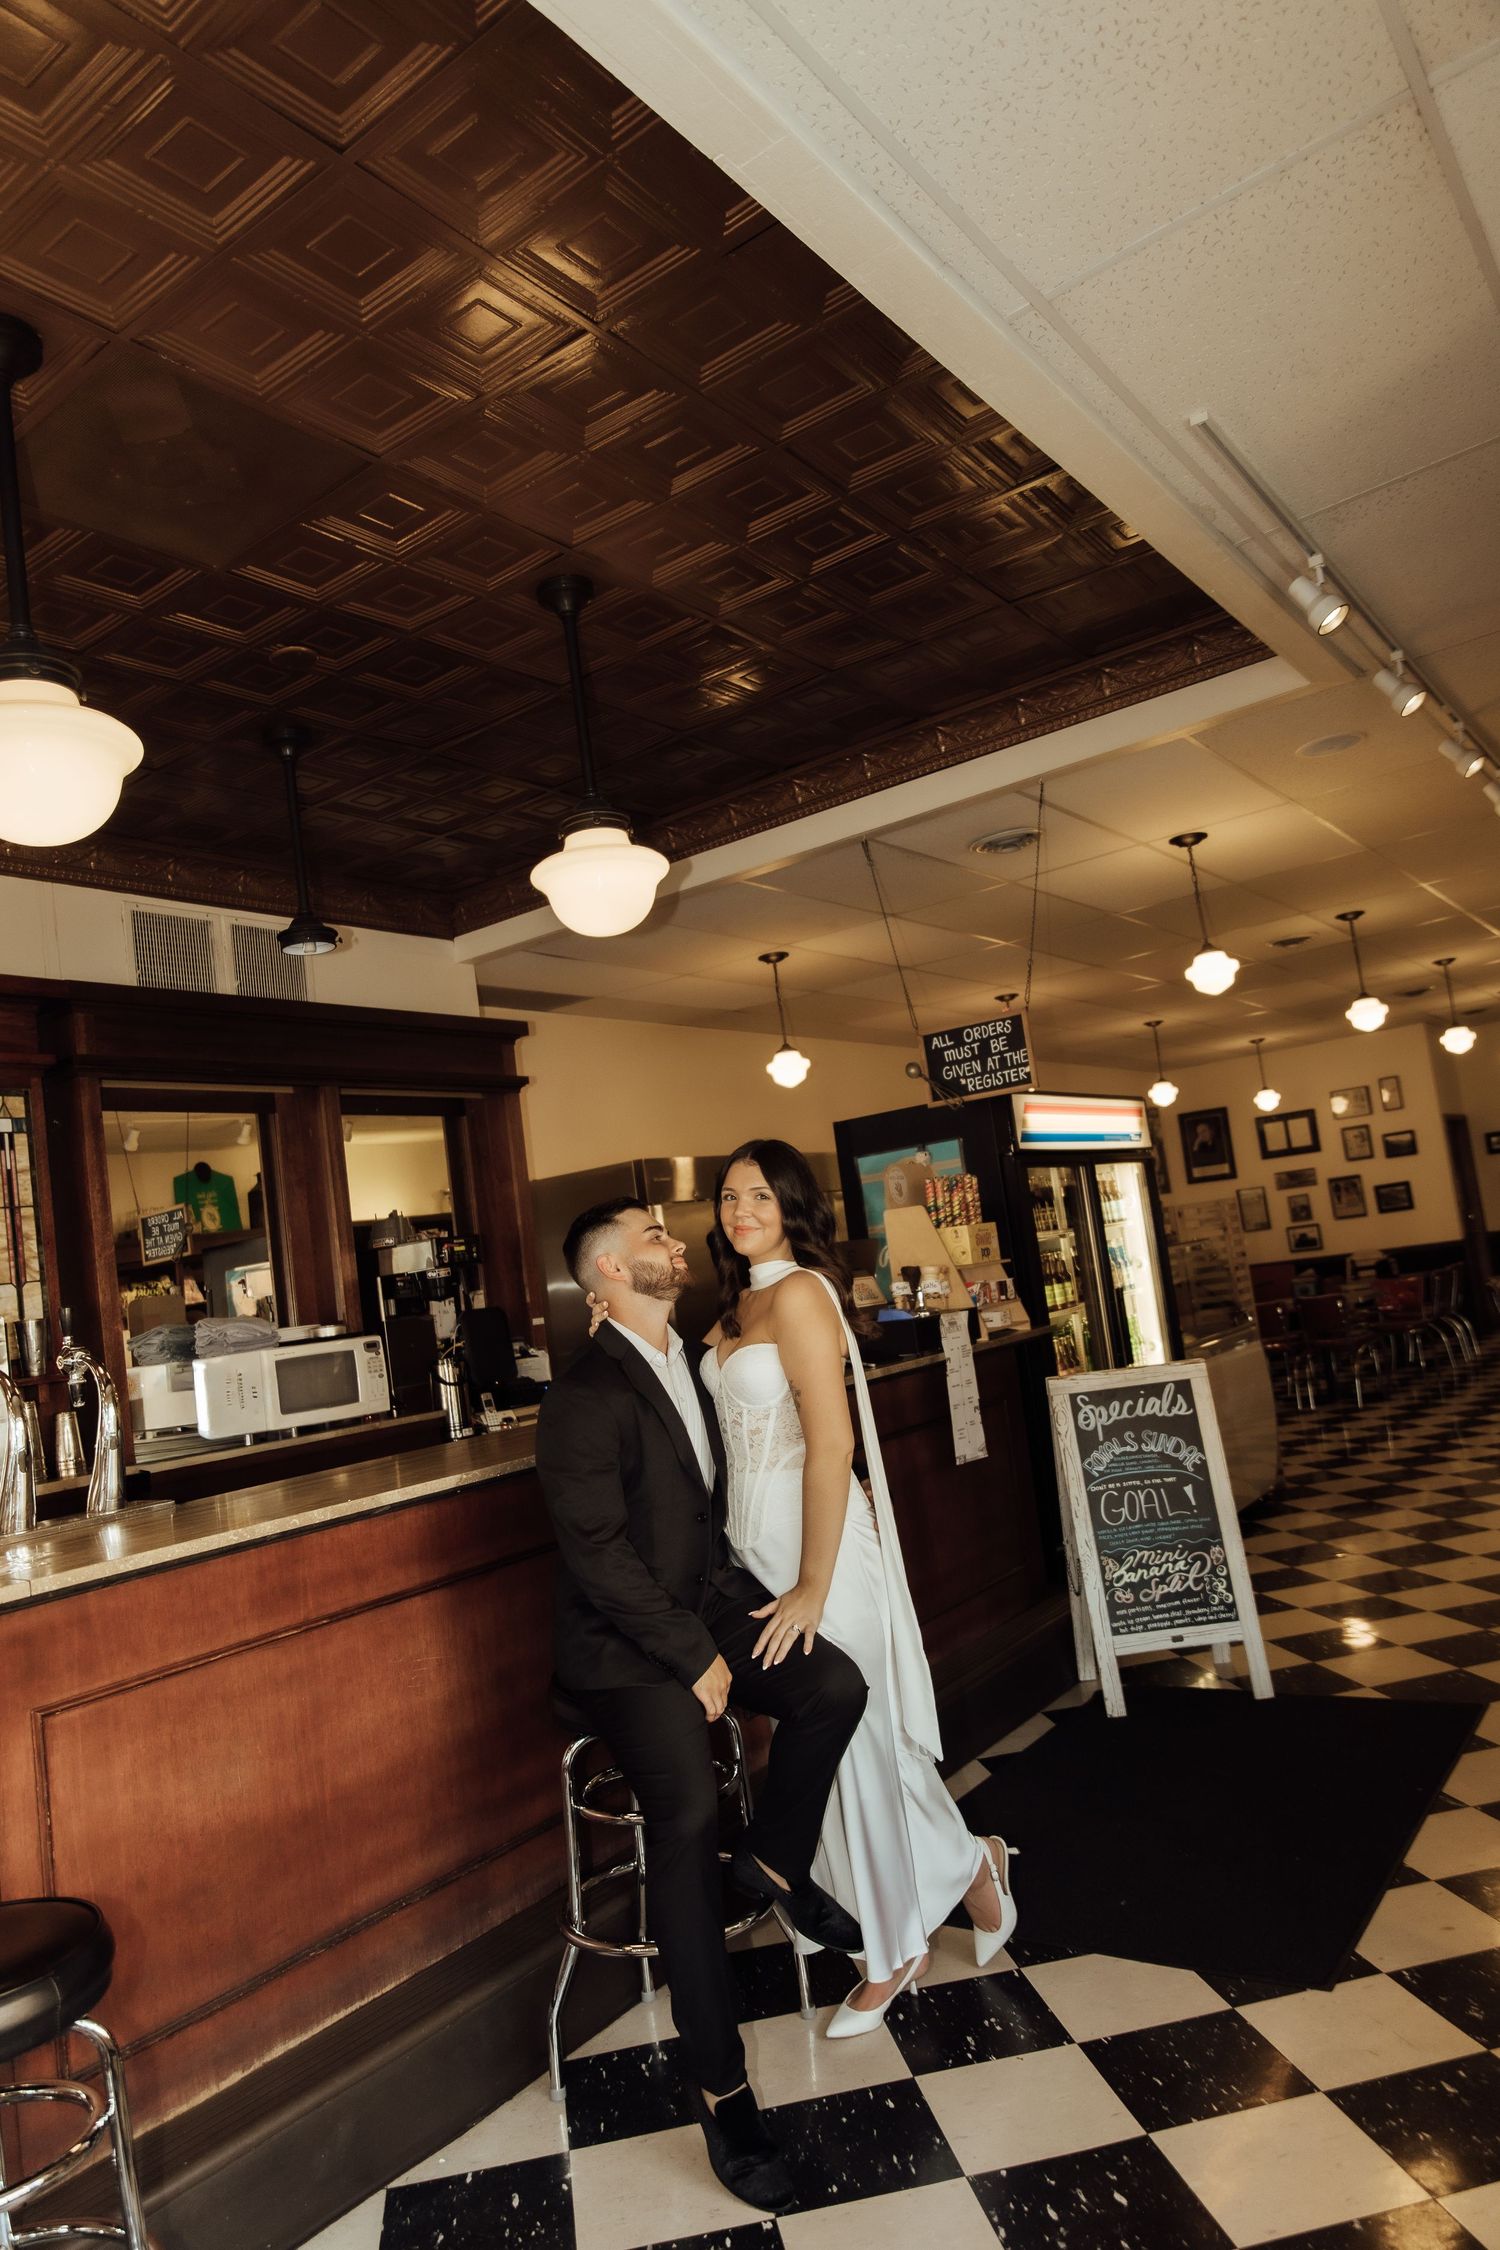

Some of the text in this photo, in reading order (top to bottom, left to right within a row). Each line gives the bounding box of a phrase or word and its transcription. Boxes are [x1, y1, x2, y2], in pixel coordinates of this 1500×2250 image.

[932, 1020, 1012, 1049] ALL ORDERS
[944, 1036, 1009, 1062] MUST BE
[942, 1048, 1029, 1080] GIVEN AT THE
[1076, 1383, 1193, 1441] Specials
[1082, 1429, 1205, 1477] ROYALS SUNDAE
[1101, 1483, 1198, 1526] GOAL!
[1140, 1552, 1211, 1602] Split
